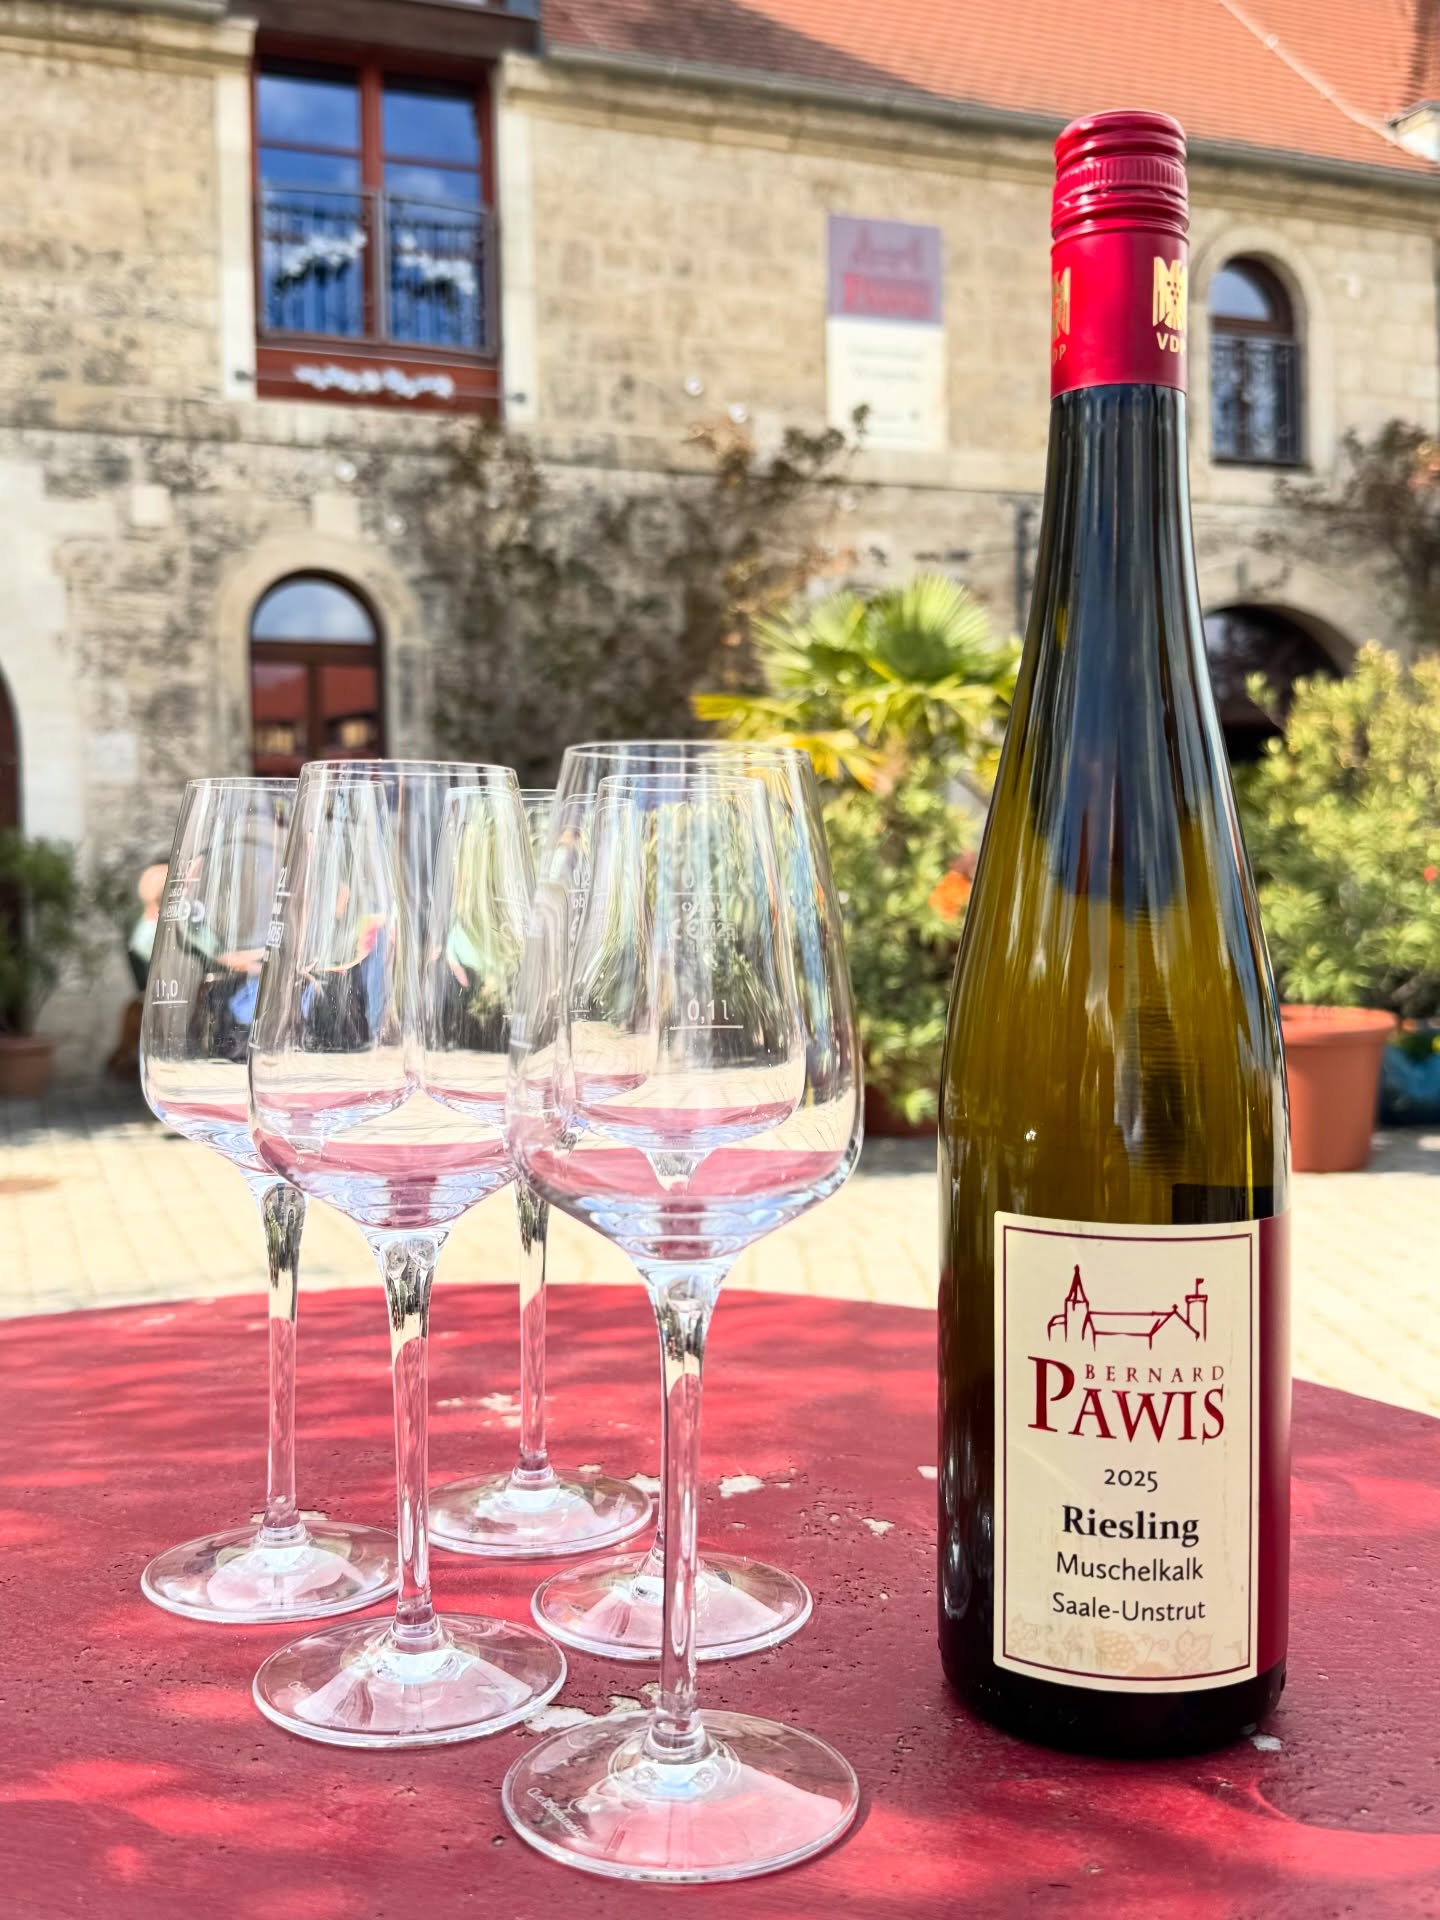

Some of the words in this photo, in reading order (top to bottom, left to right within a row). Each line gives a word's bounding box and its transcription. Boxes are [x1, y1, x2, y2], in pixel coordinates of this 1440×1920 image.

[1084, 1363, 1225, 1383] BERNARD
[1027, 1355, 1225, 1445] PAWIS
[1103, 1468, 1159, 1493] 2025
[1061, 1504, 1200, 1548] Riesling
[1055, 1551, 1204, 1582] Muschelkalk
[1051, 1591, 1207, 1622] Saale-Unstrut
